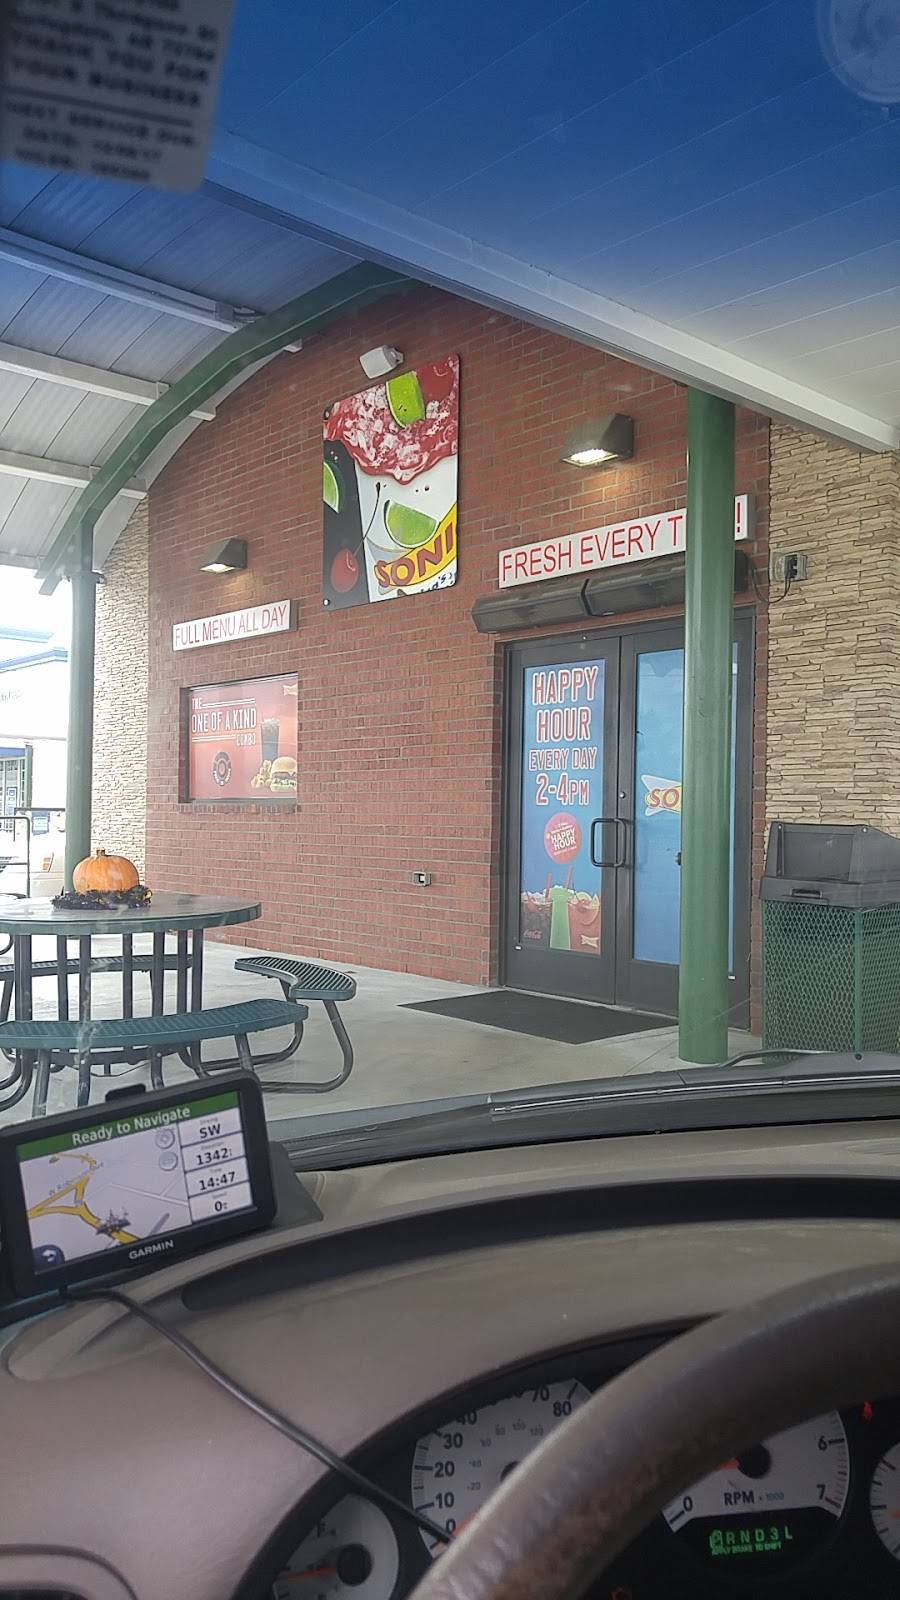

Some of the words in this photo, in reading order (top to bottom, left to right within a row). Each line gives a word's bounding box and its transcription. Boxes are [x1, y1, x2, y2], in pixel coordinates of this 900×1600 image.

[502, 541, 572, 582] FRESH
[580, 520, 661, 565] EVERY
[175, 623, 200, 648] FULL
[203, 616, 236, 641] MENU
[238, 612, 259, 634] ALL
[261, 604, 287, 630] DAY
[532, 666, 599, 705] HAPPY
[192, 698, 203, 710] THE
[192, 713, 208, 733] ONE
[211, 712, 222, 732] OF
[225, 711, 231, 730] A
[233, 708, 256, 730] KIND
[536, 707, 592, 743] HOUR
[236, 733, 256, 746] COMBO
[529, 748, 569, 771] EVERY
[572, 747, 597, 770] DAY
[536, 772, 590, 806] 2-4PM
[551, 827, 575, 843] HAPPY
[554, 837, 576, 851] HOUR
[72, 1126, 112, 1146] Ready
[117, 1123, 130, 1135] to
[134, 1107, 191, 1130] Navigate
[200, 1123, 220, 1139] SW
[196, 1148, 228, 1165] 1342
[200, 1171, 235, 1191] 14:47
[214, 1201, 222, 1212] 0
[129, 1240, 174, 1259] GARMIN
[552, 1400, 572, 1417] 80
[442, 1432, 463, 1449] 30
[818, 1435, 828, 1451] 6
[434, 1461, 455, 1478] 20
[436, 1492, 455, 1508] 10
[724, 1491, 755, 1506] RPM
[816, 1484, 826, 1500] 7
[683, 1496, 693, 1512] 0
[445, 1519, 456, 1533] 0
